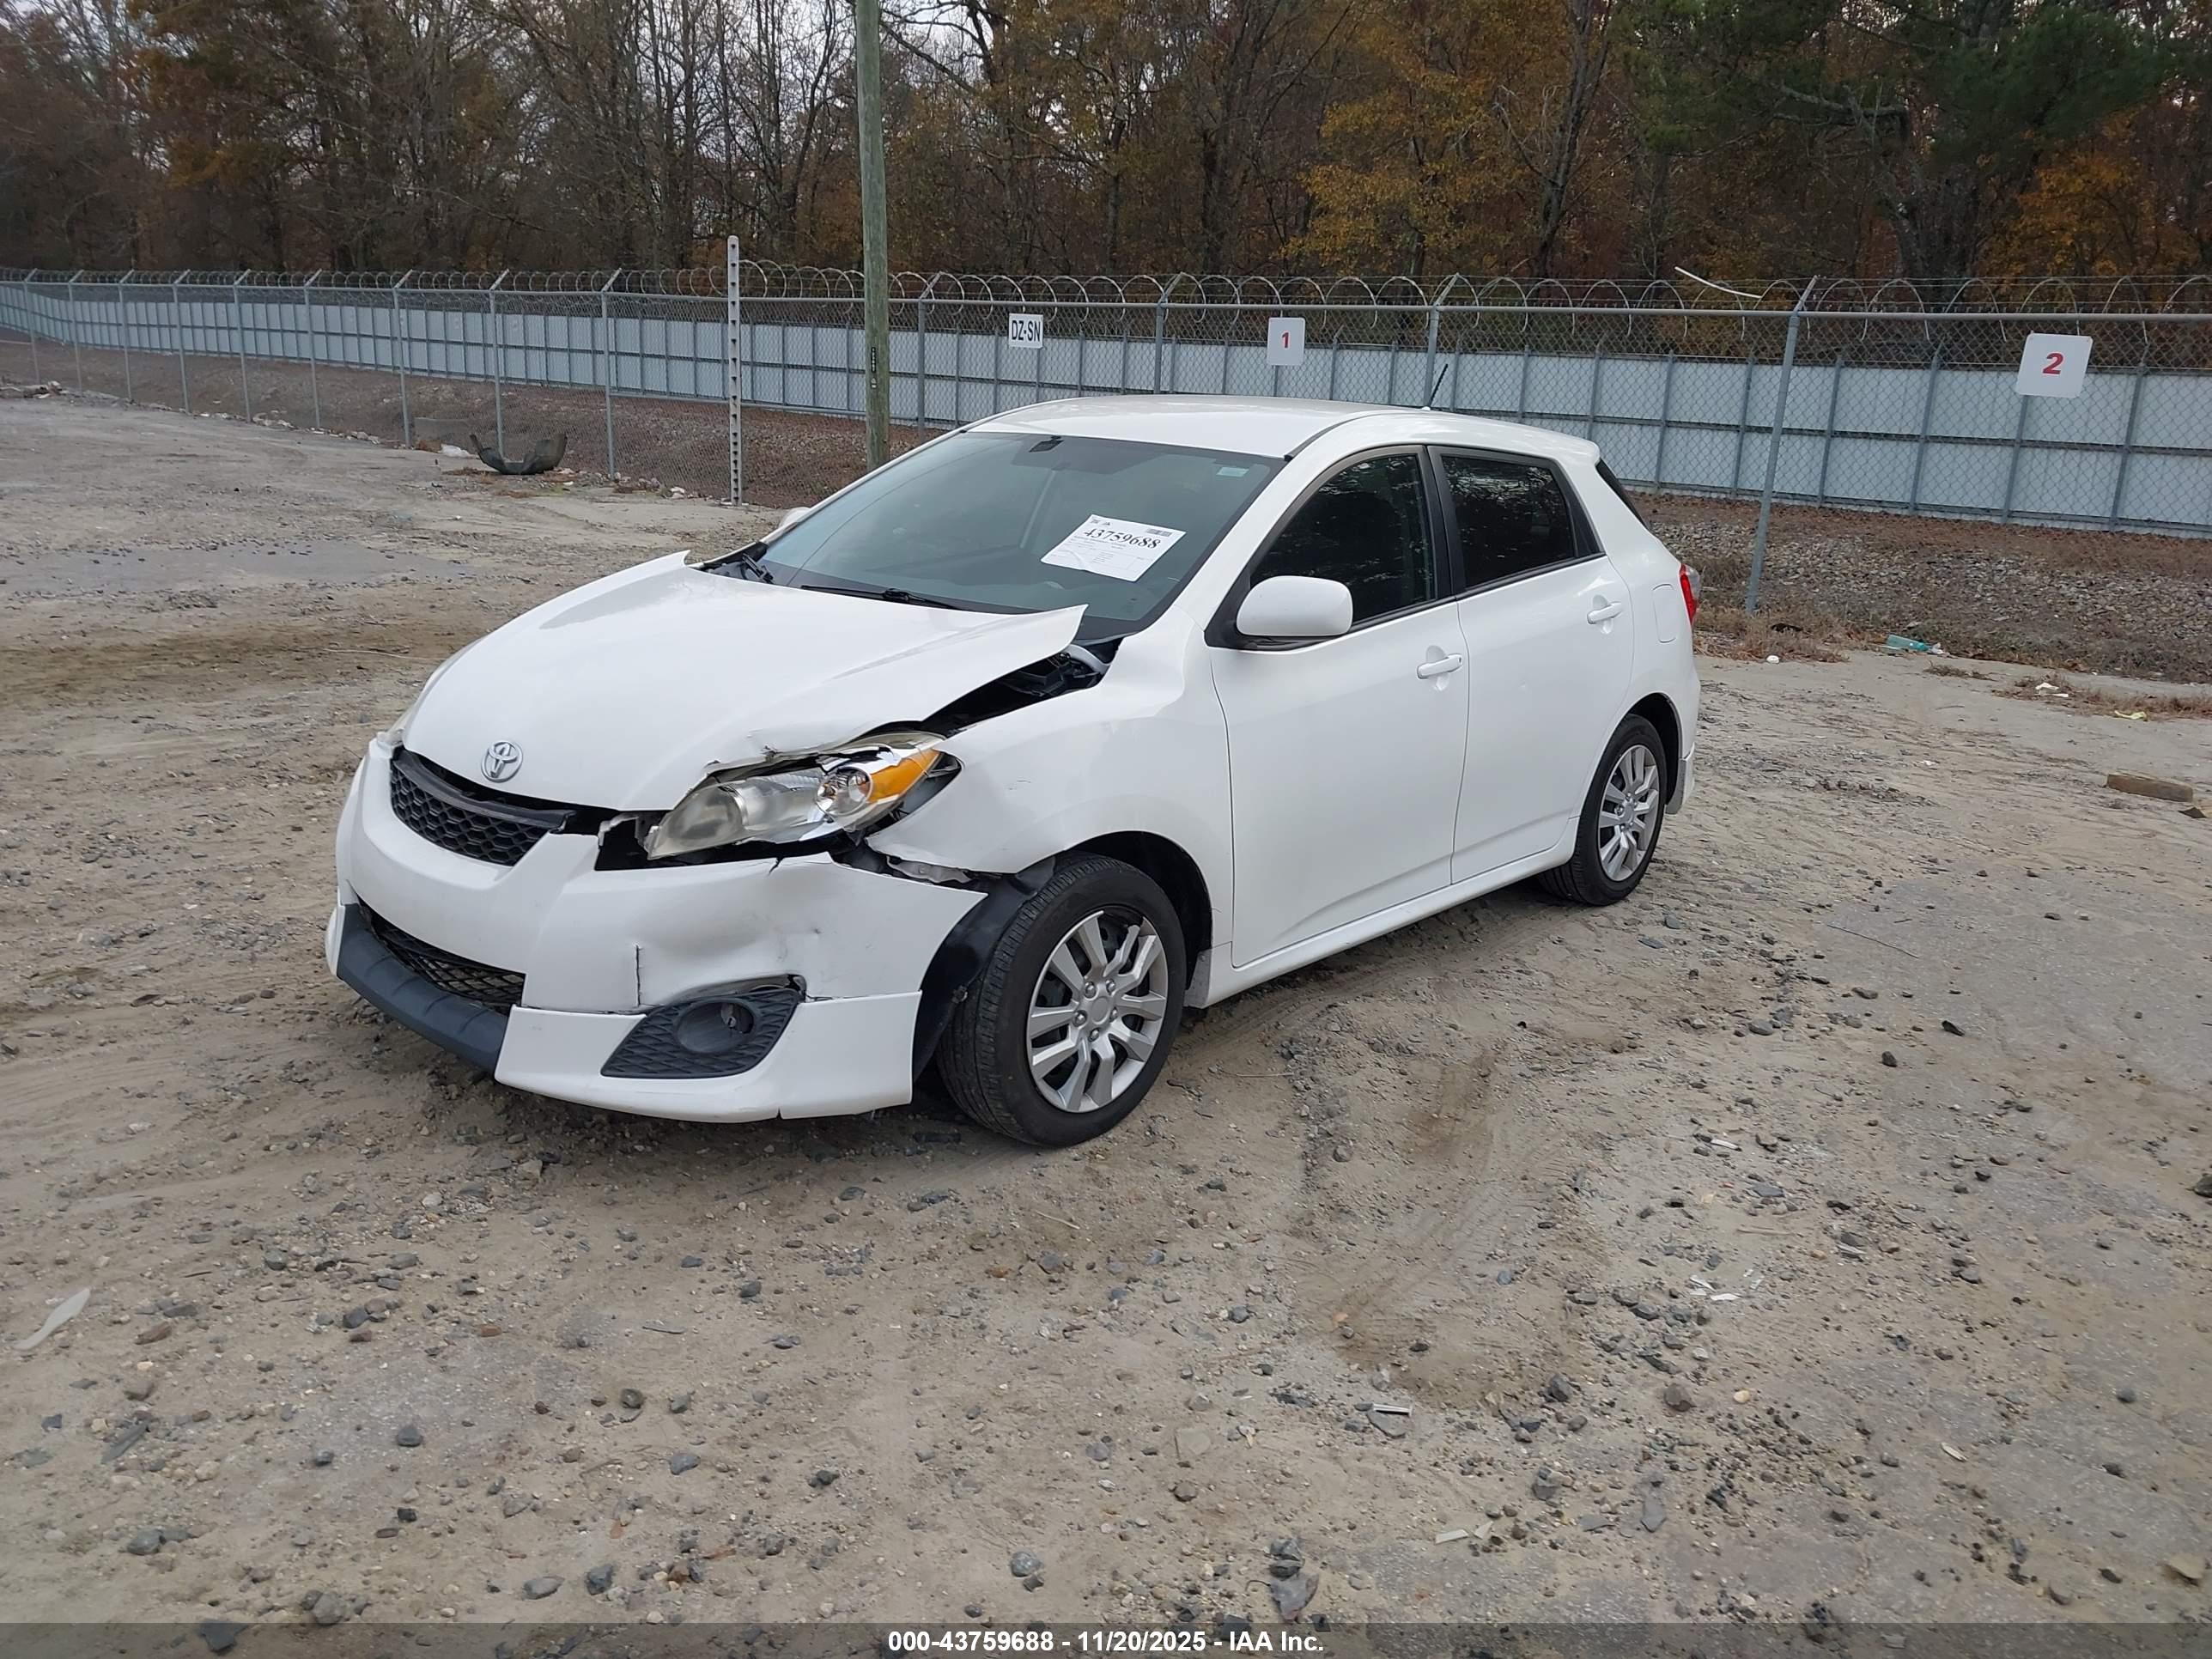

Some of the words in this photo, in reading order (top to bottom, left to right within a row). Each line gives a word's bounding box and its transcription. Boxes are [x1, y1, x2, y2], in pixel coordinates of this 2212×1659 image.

[1012, 320, 1041, 342] DZ-SN
[1281, 331, 1290, 349] 1
[2042, 352, 2063, 374] 2
[1084, 528, 1161, 549] 43759688
